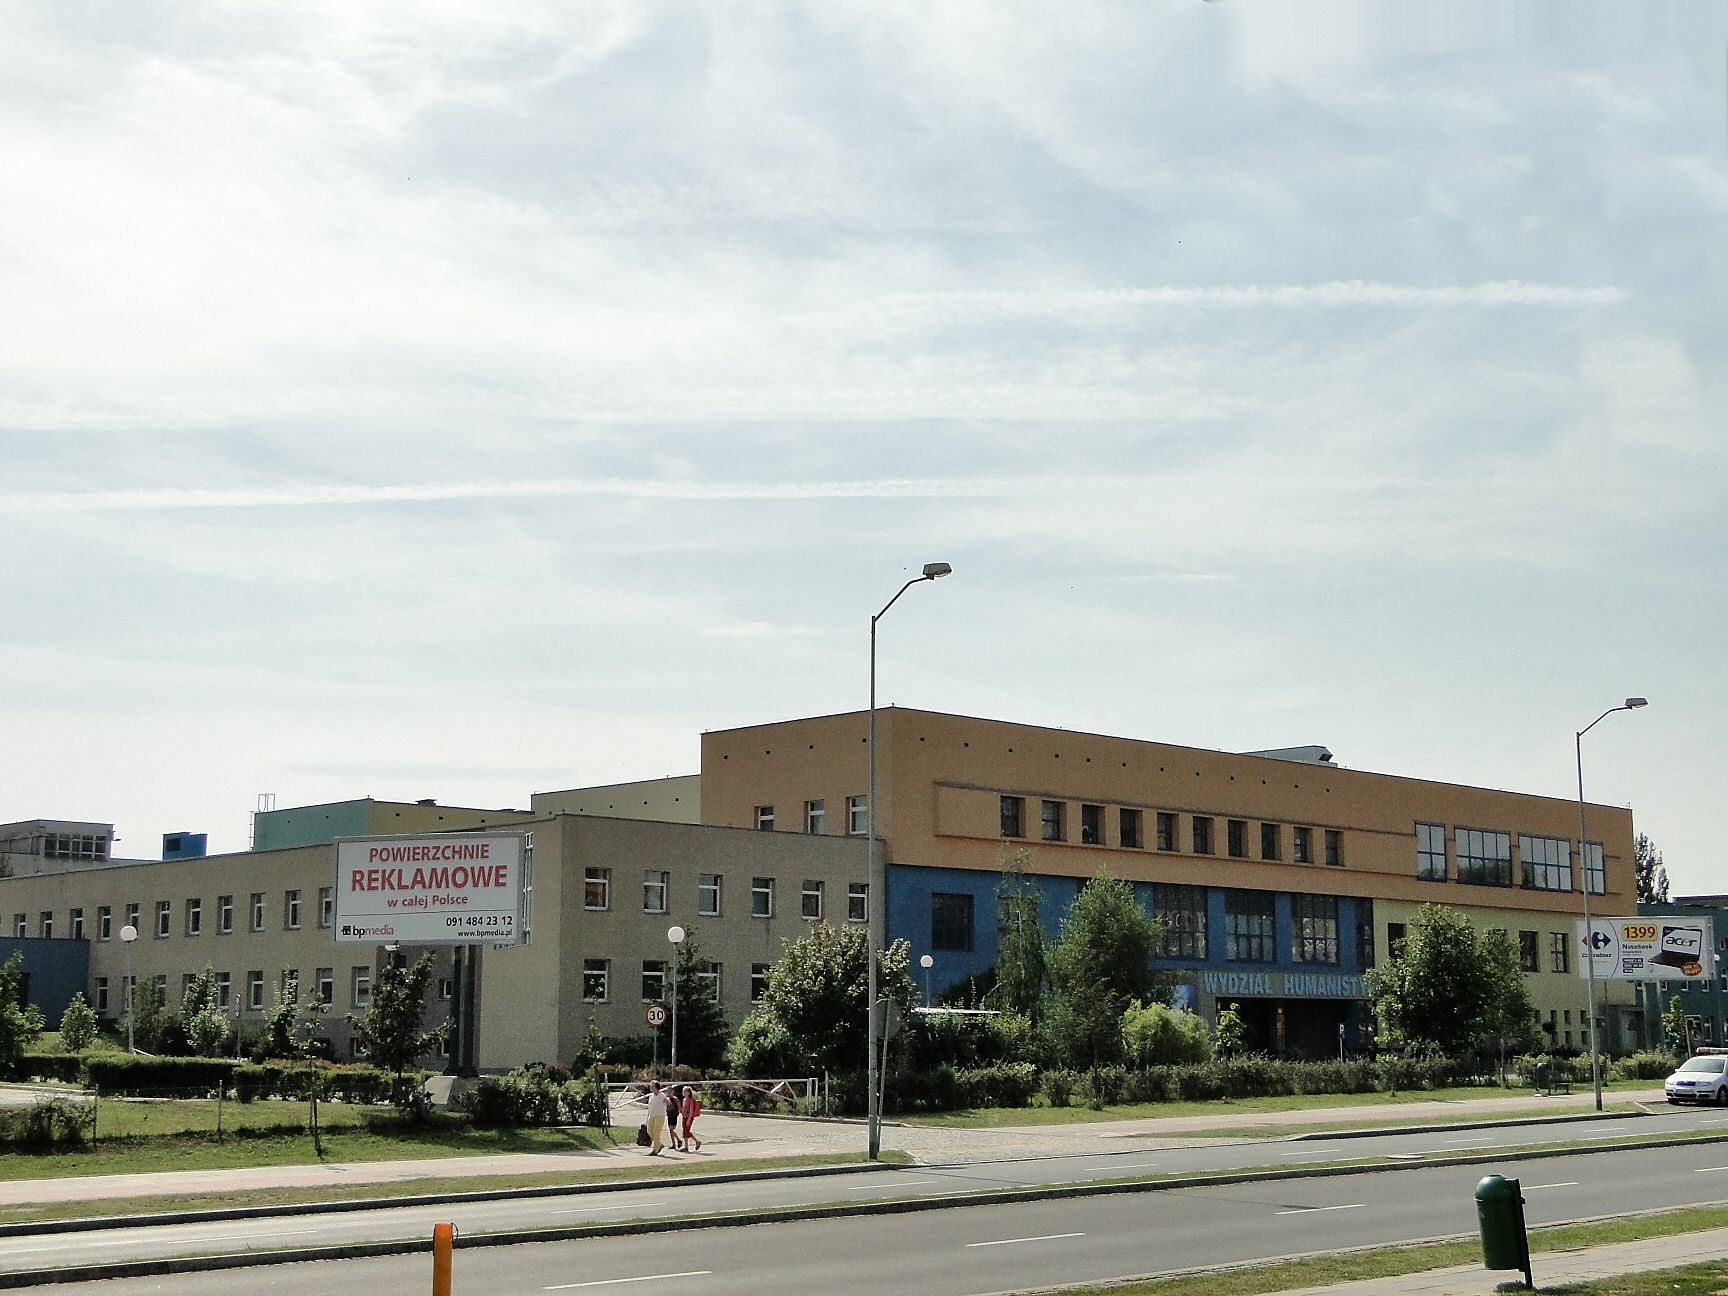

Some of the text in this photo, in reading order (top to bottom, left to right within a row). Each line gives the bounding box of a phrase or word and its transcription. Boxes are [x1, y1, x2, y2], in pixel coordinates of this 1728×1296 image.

[369, 844, 490, 863] POWIERZCHNIE
[352, 865, 508, 892] REKLAMOWE
[388, 894, 469, 909] w całej Polsce
[446, 916, 513, 927] 091 484 23 12
[352, 924, 394, 939] bpmedia
[458, 929, 513, 938] www.bpmedia.pl
[1623, 926, 1656, 939] 1399
[1666, 936, 1698, 947] acer
[1204, 972, 1370, 997] WYDZIAŁ HUMANISTY
[649, 1010, 664, 1021] 30
[1339, 1024, 1345, 1035] P
